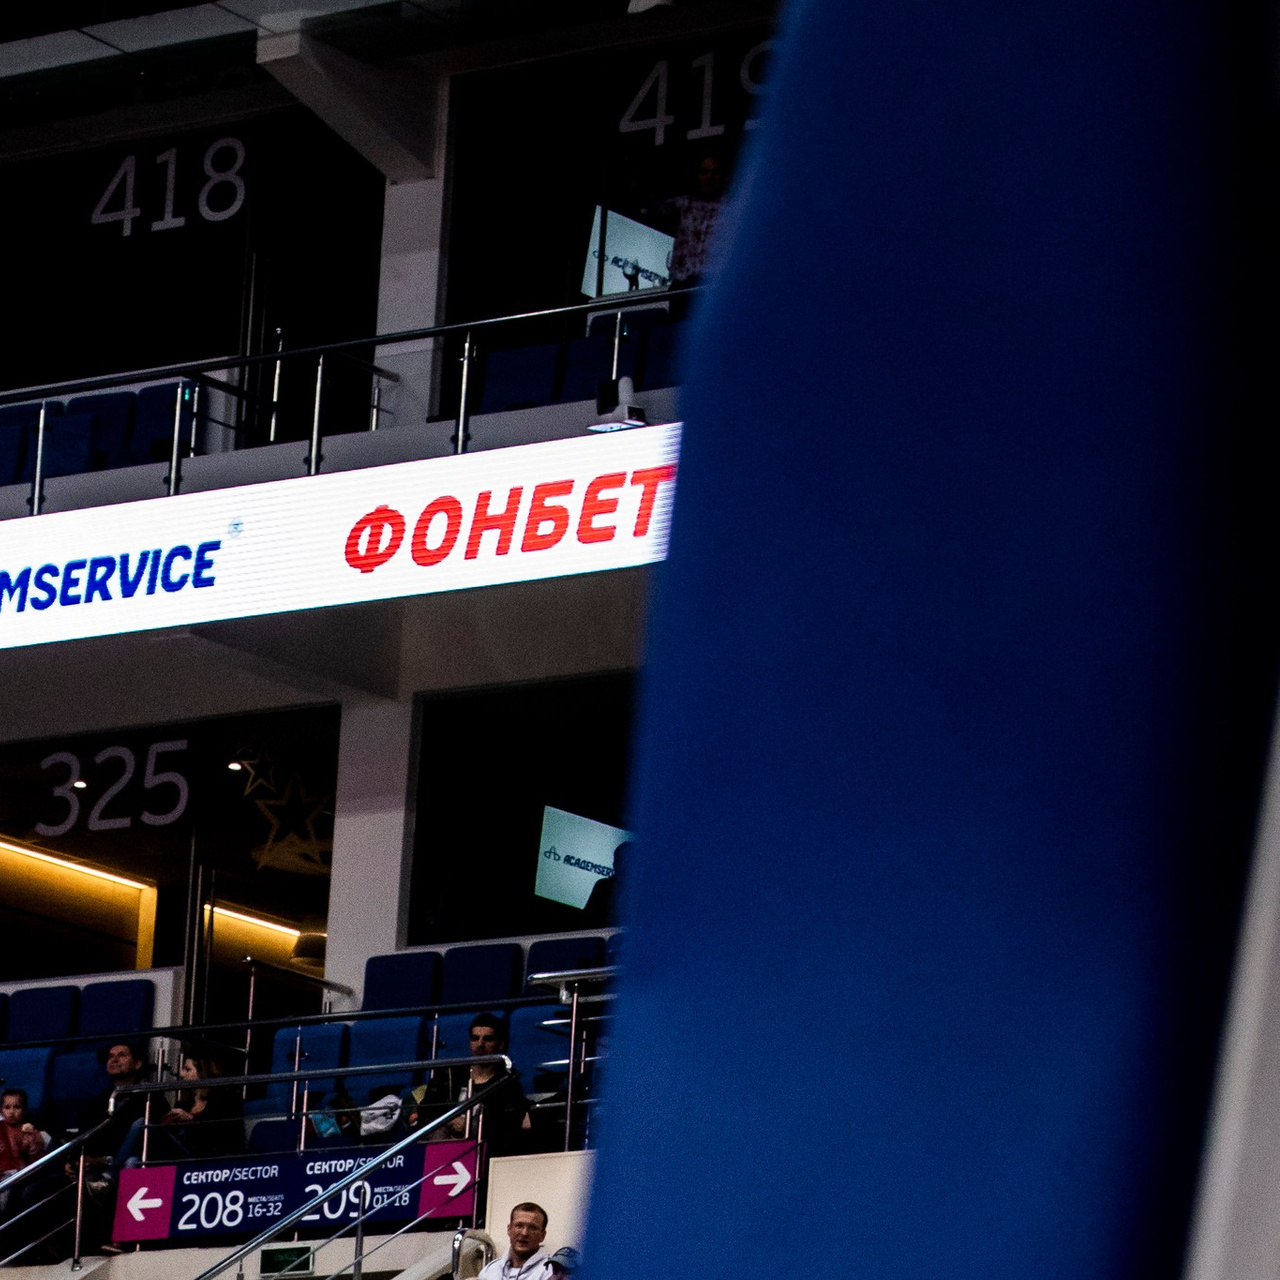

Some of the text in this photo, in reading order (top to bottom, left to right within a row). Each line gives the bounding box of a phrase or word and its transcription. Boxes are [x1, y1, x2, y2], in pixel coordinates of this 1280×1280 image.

[91, 137, 247, 236] 418
[344, 464, 677, 573] ФОНБЕТ
[34, 738, 190, 838] 325
[178, 1190, 244, 1230] 208
[247, 1202, 282, 1218] 16-32
[301, 1180, 371, 1220] 209
[373, 1193, 409, 1207] 0118
